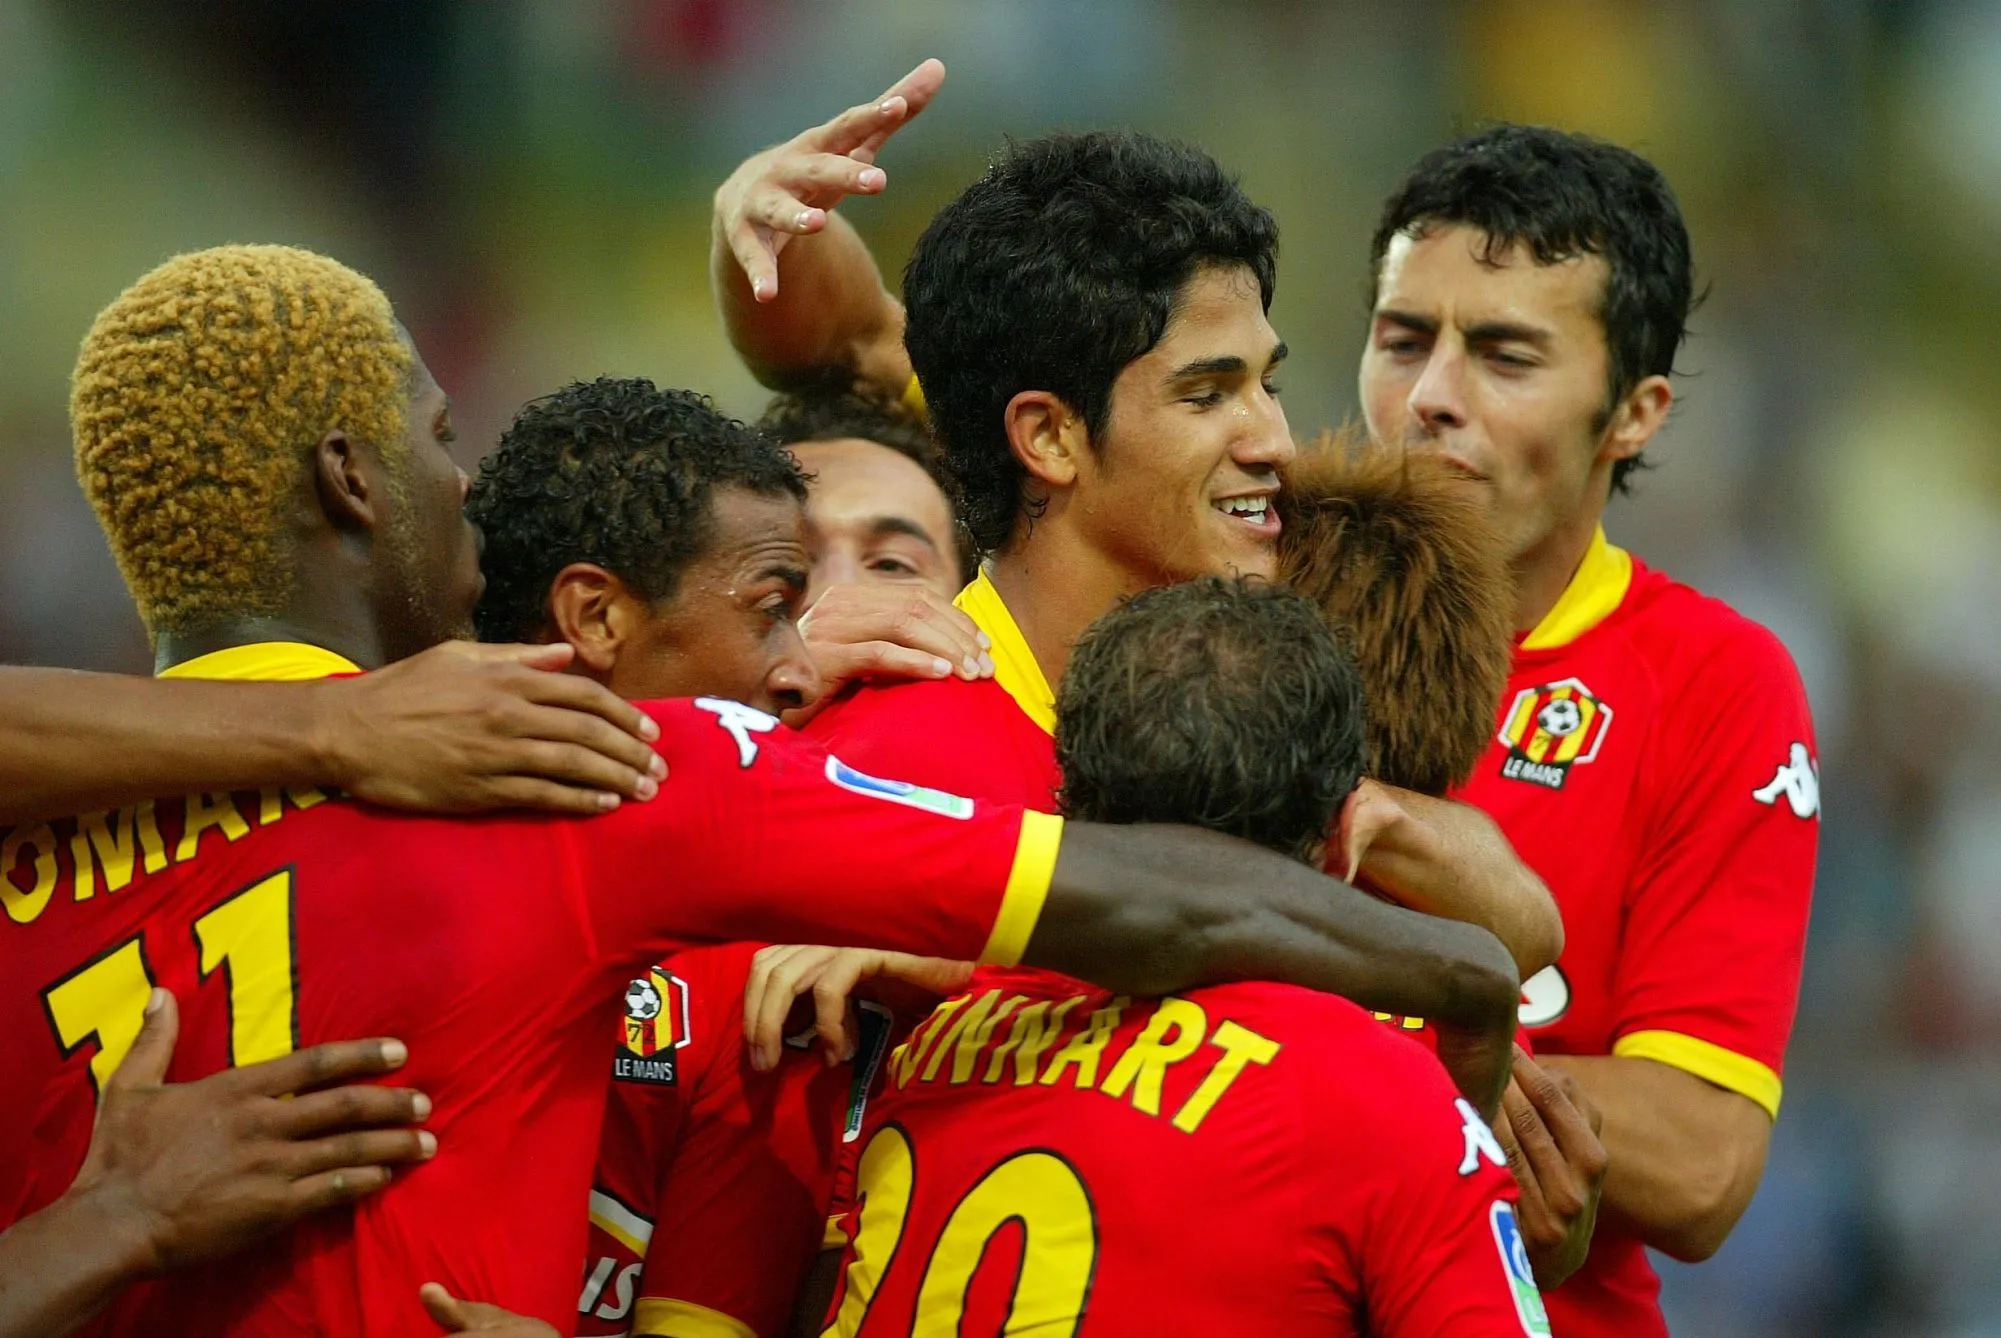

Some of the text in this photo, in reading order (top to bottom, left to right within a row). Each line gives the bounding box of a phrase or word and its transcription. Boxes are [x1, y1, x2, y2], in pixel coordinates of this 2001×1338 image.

[1503, 756, 1564, 788] LE MANS
[40, 863, 300, 1100] 11
[615, 1058, 673, 1081] LE MANS
[577, 1256, 644, 1320] IS
